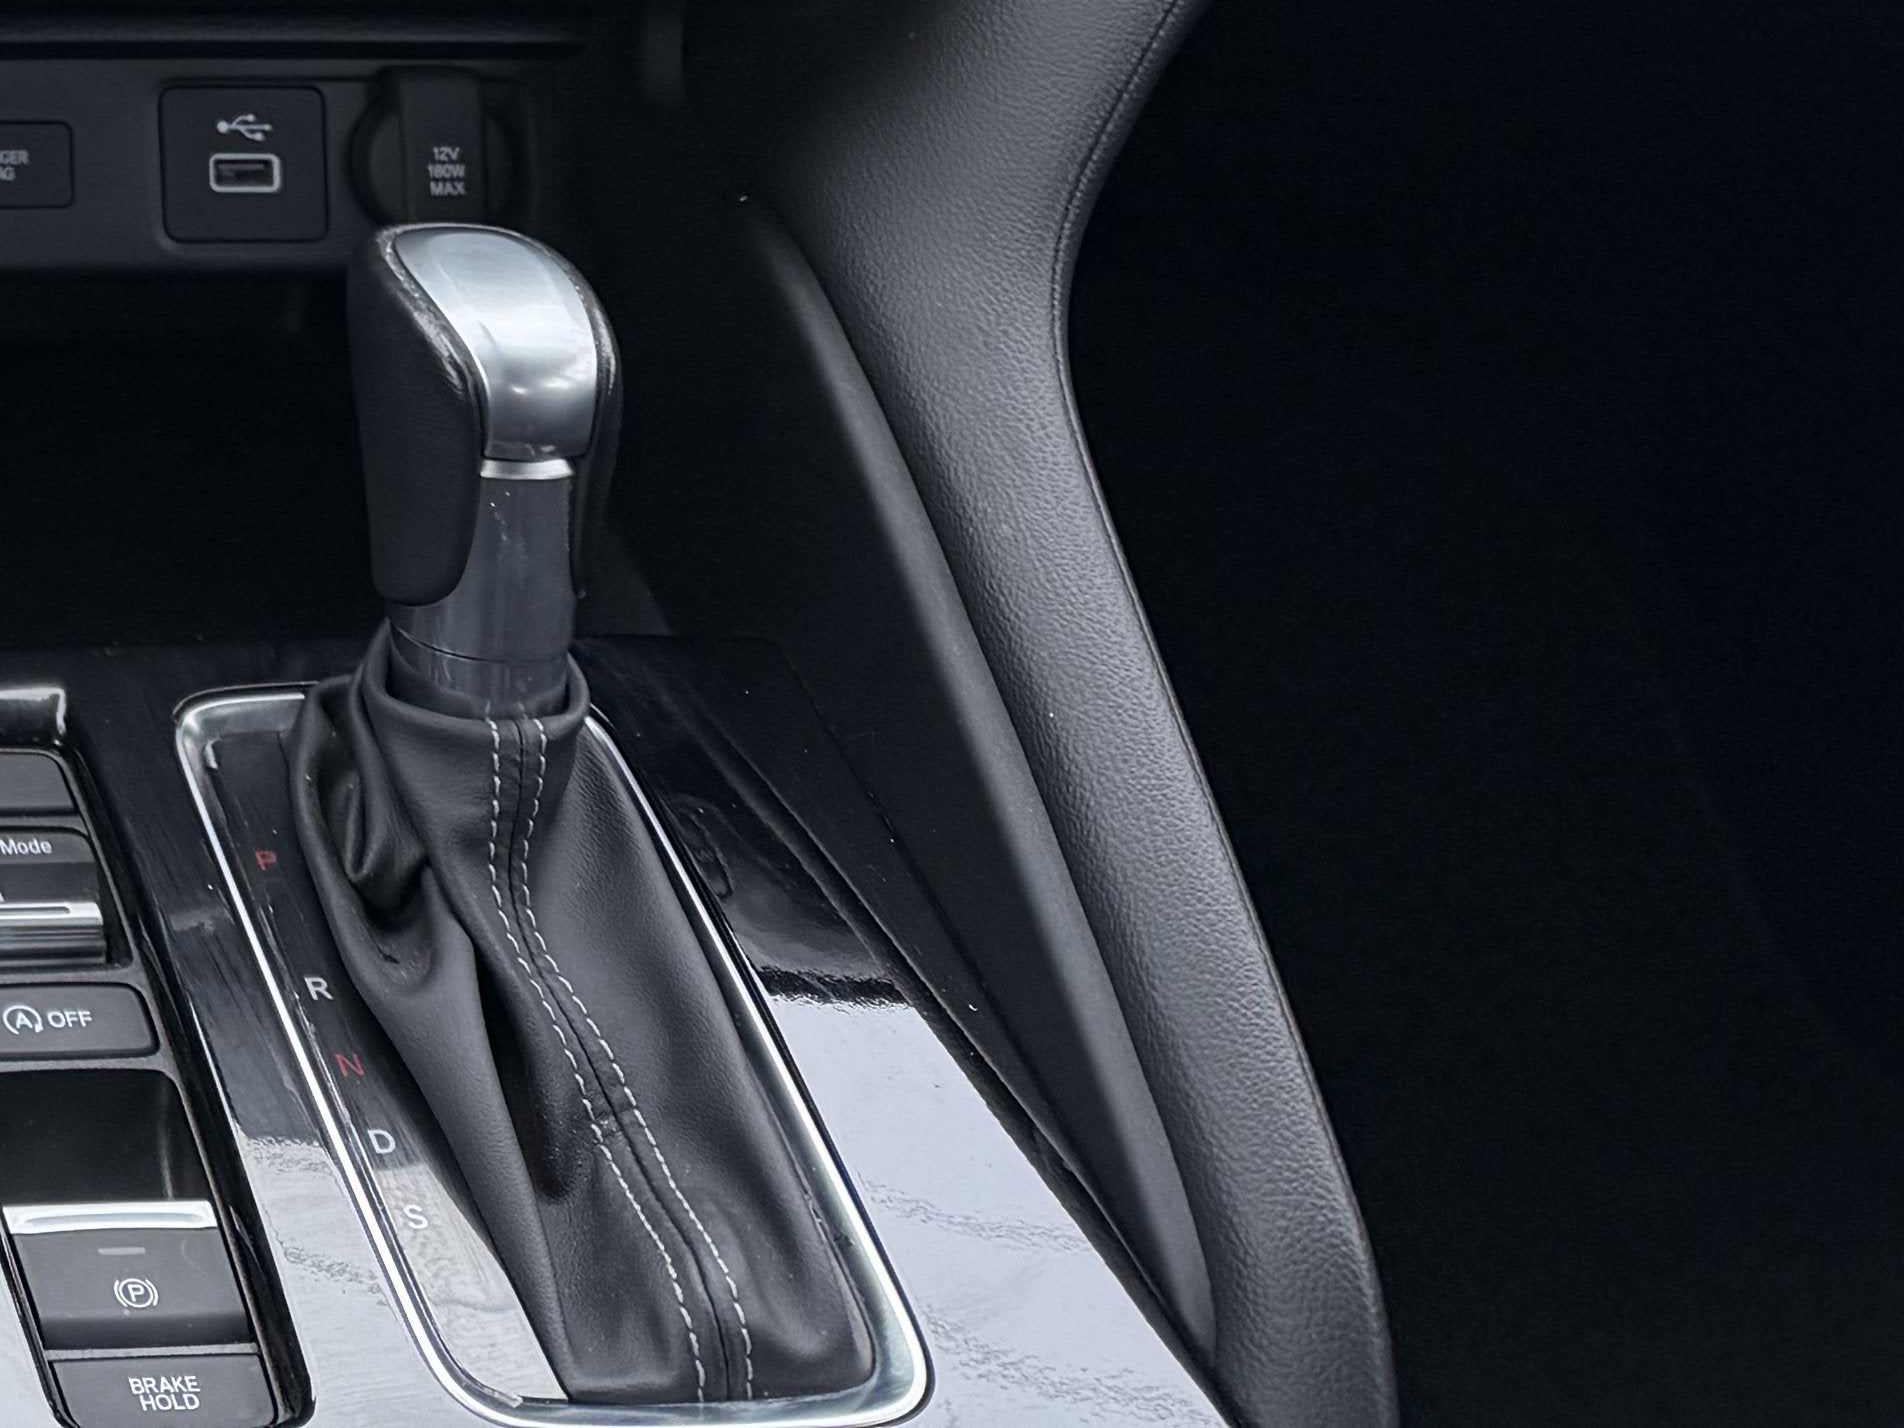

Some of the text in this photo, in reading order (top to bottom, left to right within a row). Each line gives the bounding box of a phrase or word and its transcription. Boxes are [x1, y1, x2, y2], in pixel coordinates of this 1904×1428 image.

[433, 147, 459, 161] 12V
[430, 181, 465, 195] MAX
[0, 839, 51, 854] Mode
[256, 851, 276, 870] P
[304, 977, 332, 1000] R
[47, 1010, 92, 1027] OFF
[336, 1054, 364, 1075] N
[368, 1129, 396, 1154] D
[403, 1205, 428, 1230] S
[129, 1375, 200, 1395] BRAKE
[140, 1391, 200, 1411] HOLD
